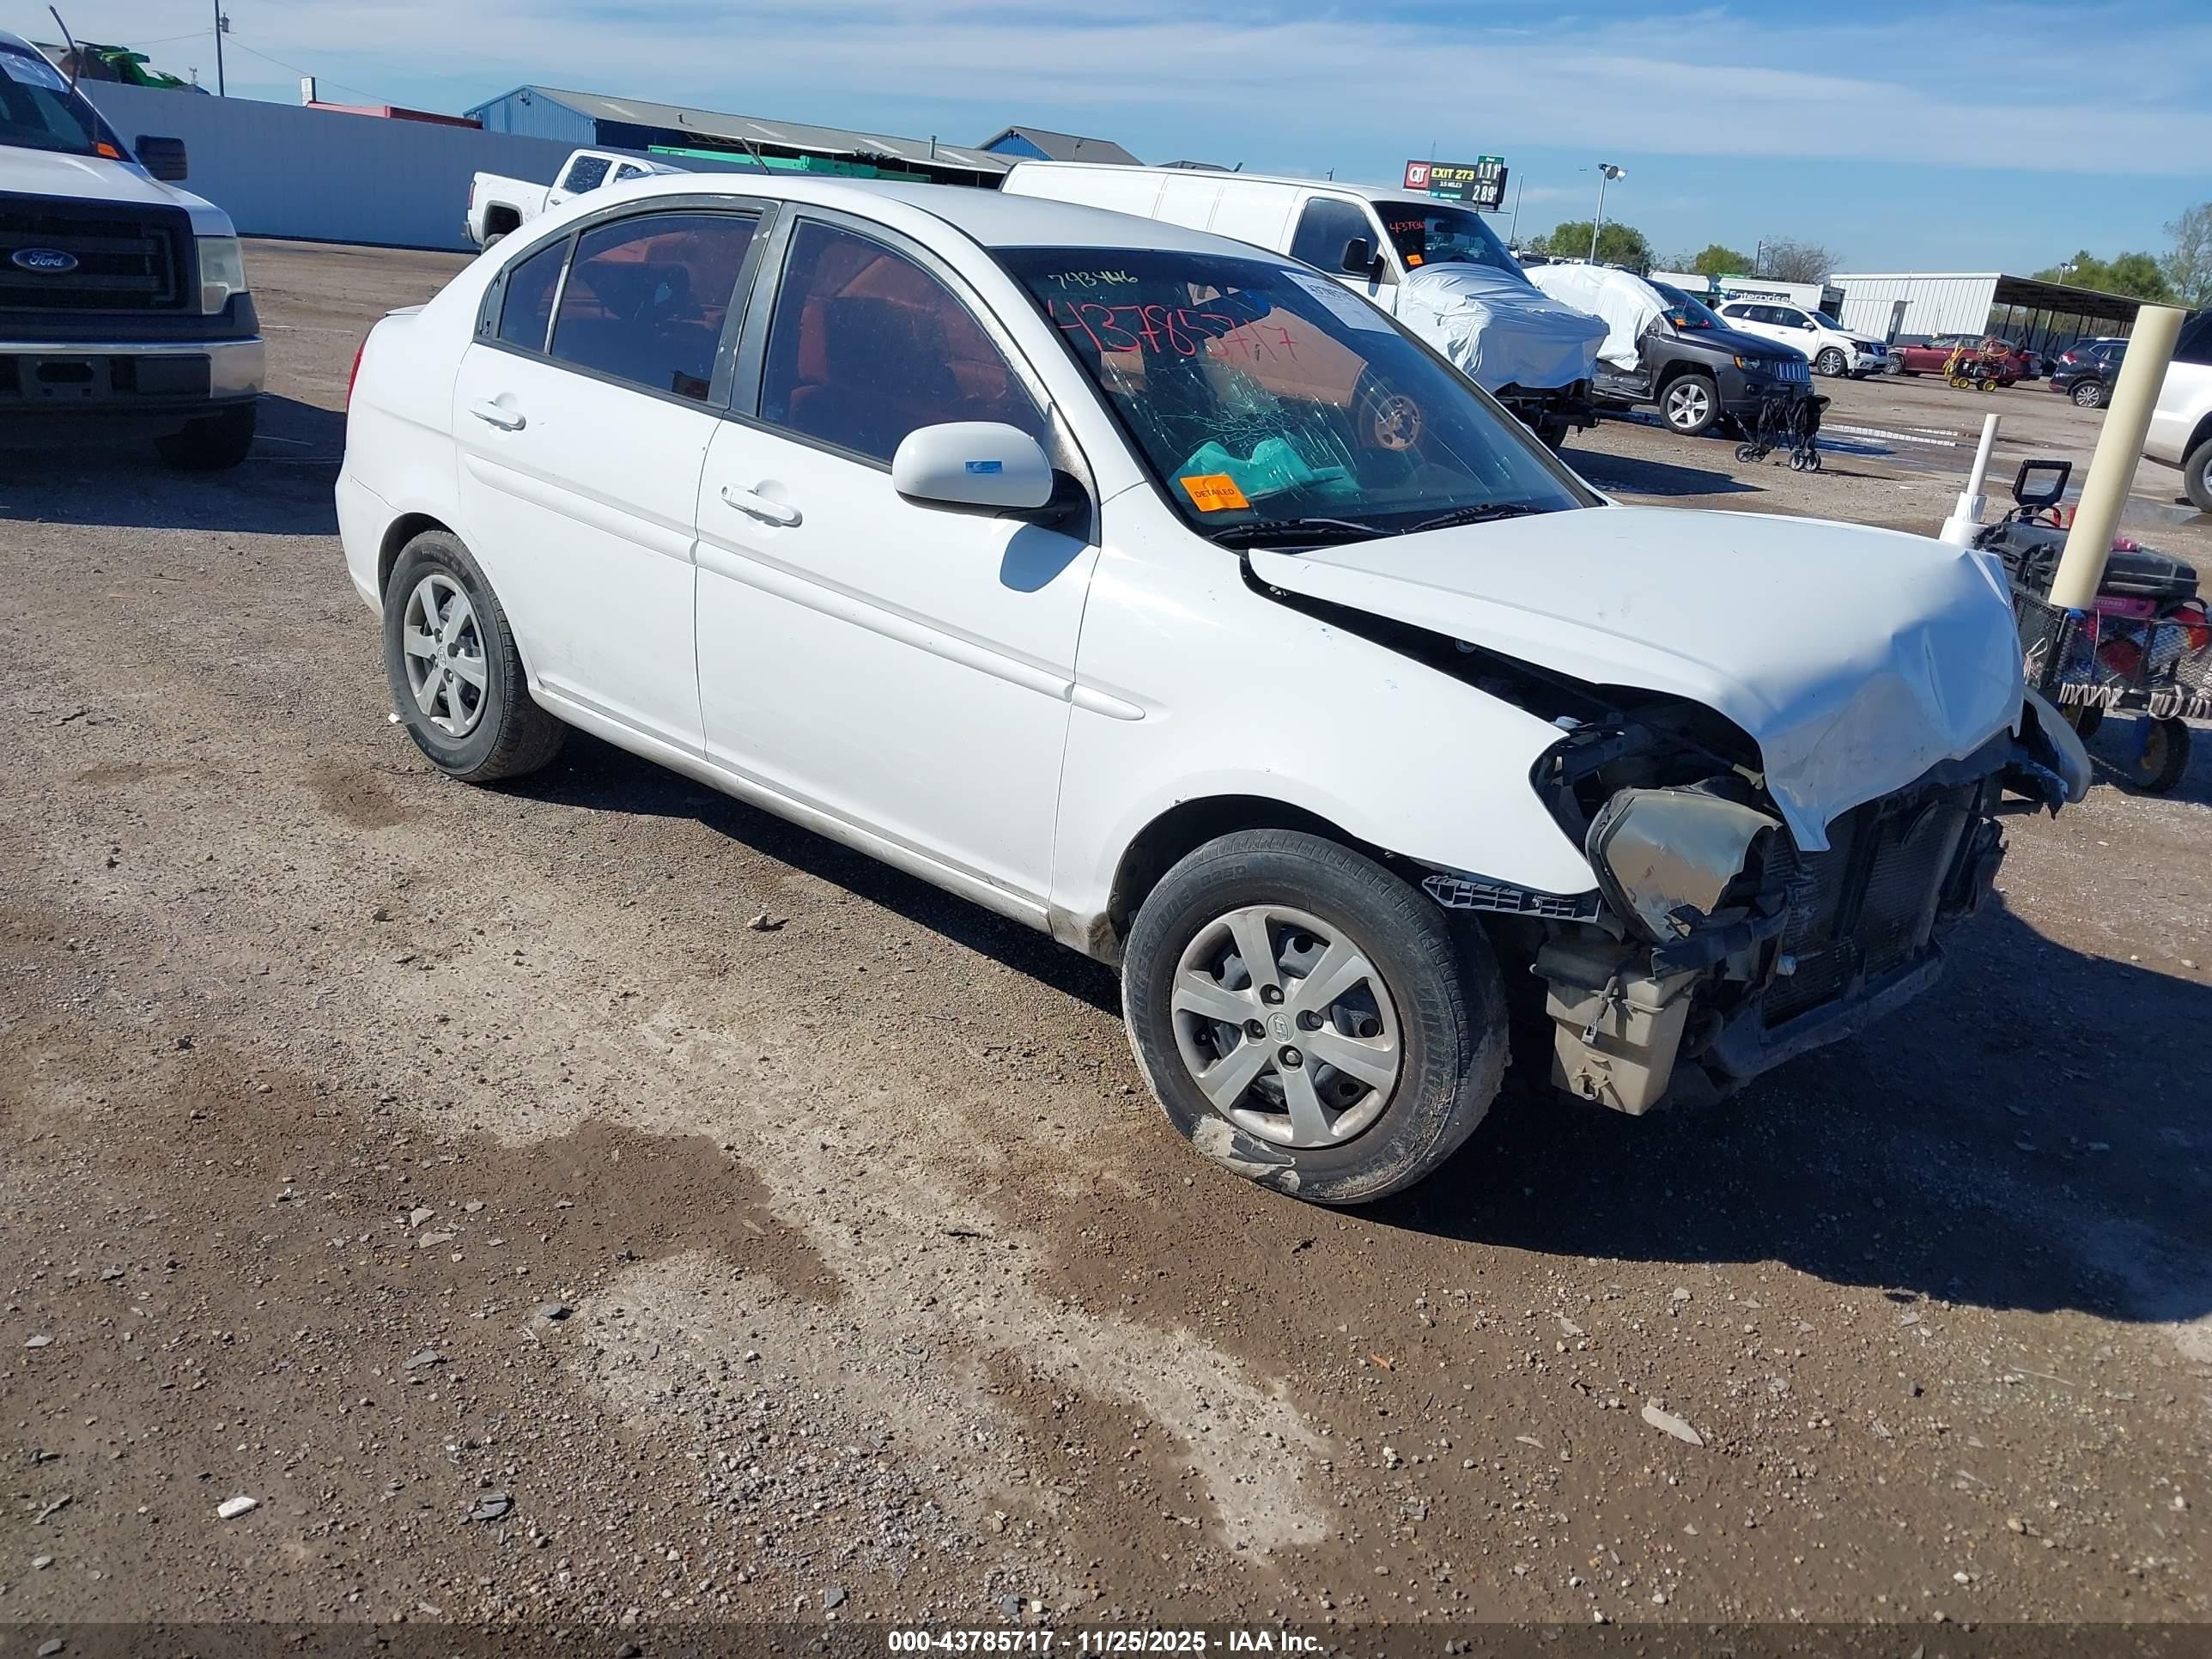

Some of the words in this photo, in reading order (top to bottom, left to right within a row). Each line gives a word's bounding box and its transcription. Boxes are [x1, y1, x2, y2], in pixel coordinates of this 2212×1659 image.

[1409, 167, 1427, 184] QT
[1431, 167, 1453, 178] EXIT
[1455, 169, 1474, 179] 273
[28, 251, 64, 266] Ford
[1729, 291, 1790, 302] Enterprise
[1047, 299, 1299, 365] 43785717
[1194, 488, 1235, 498] DETAILED
